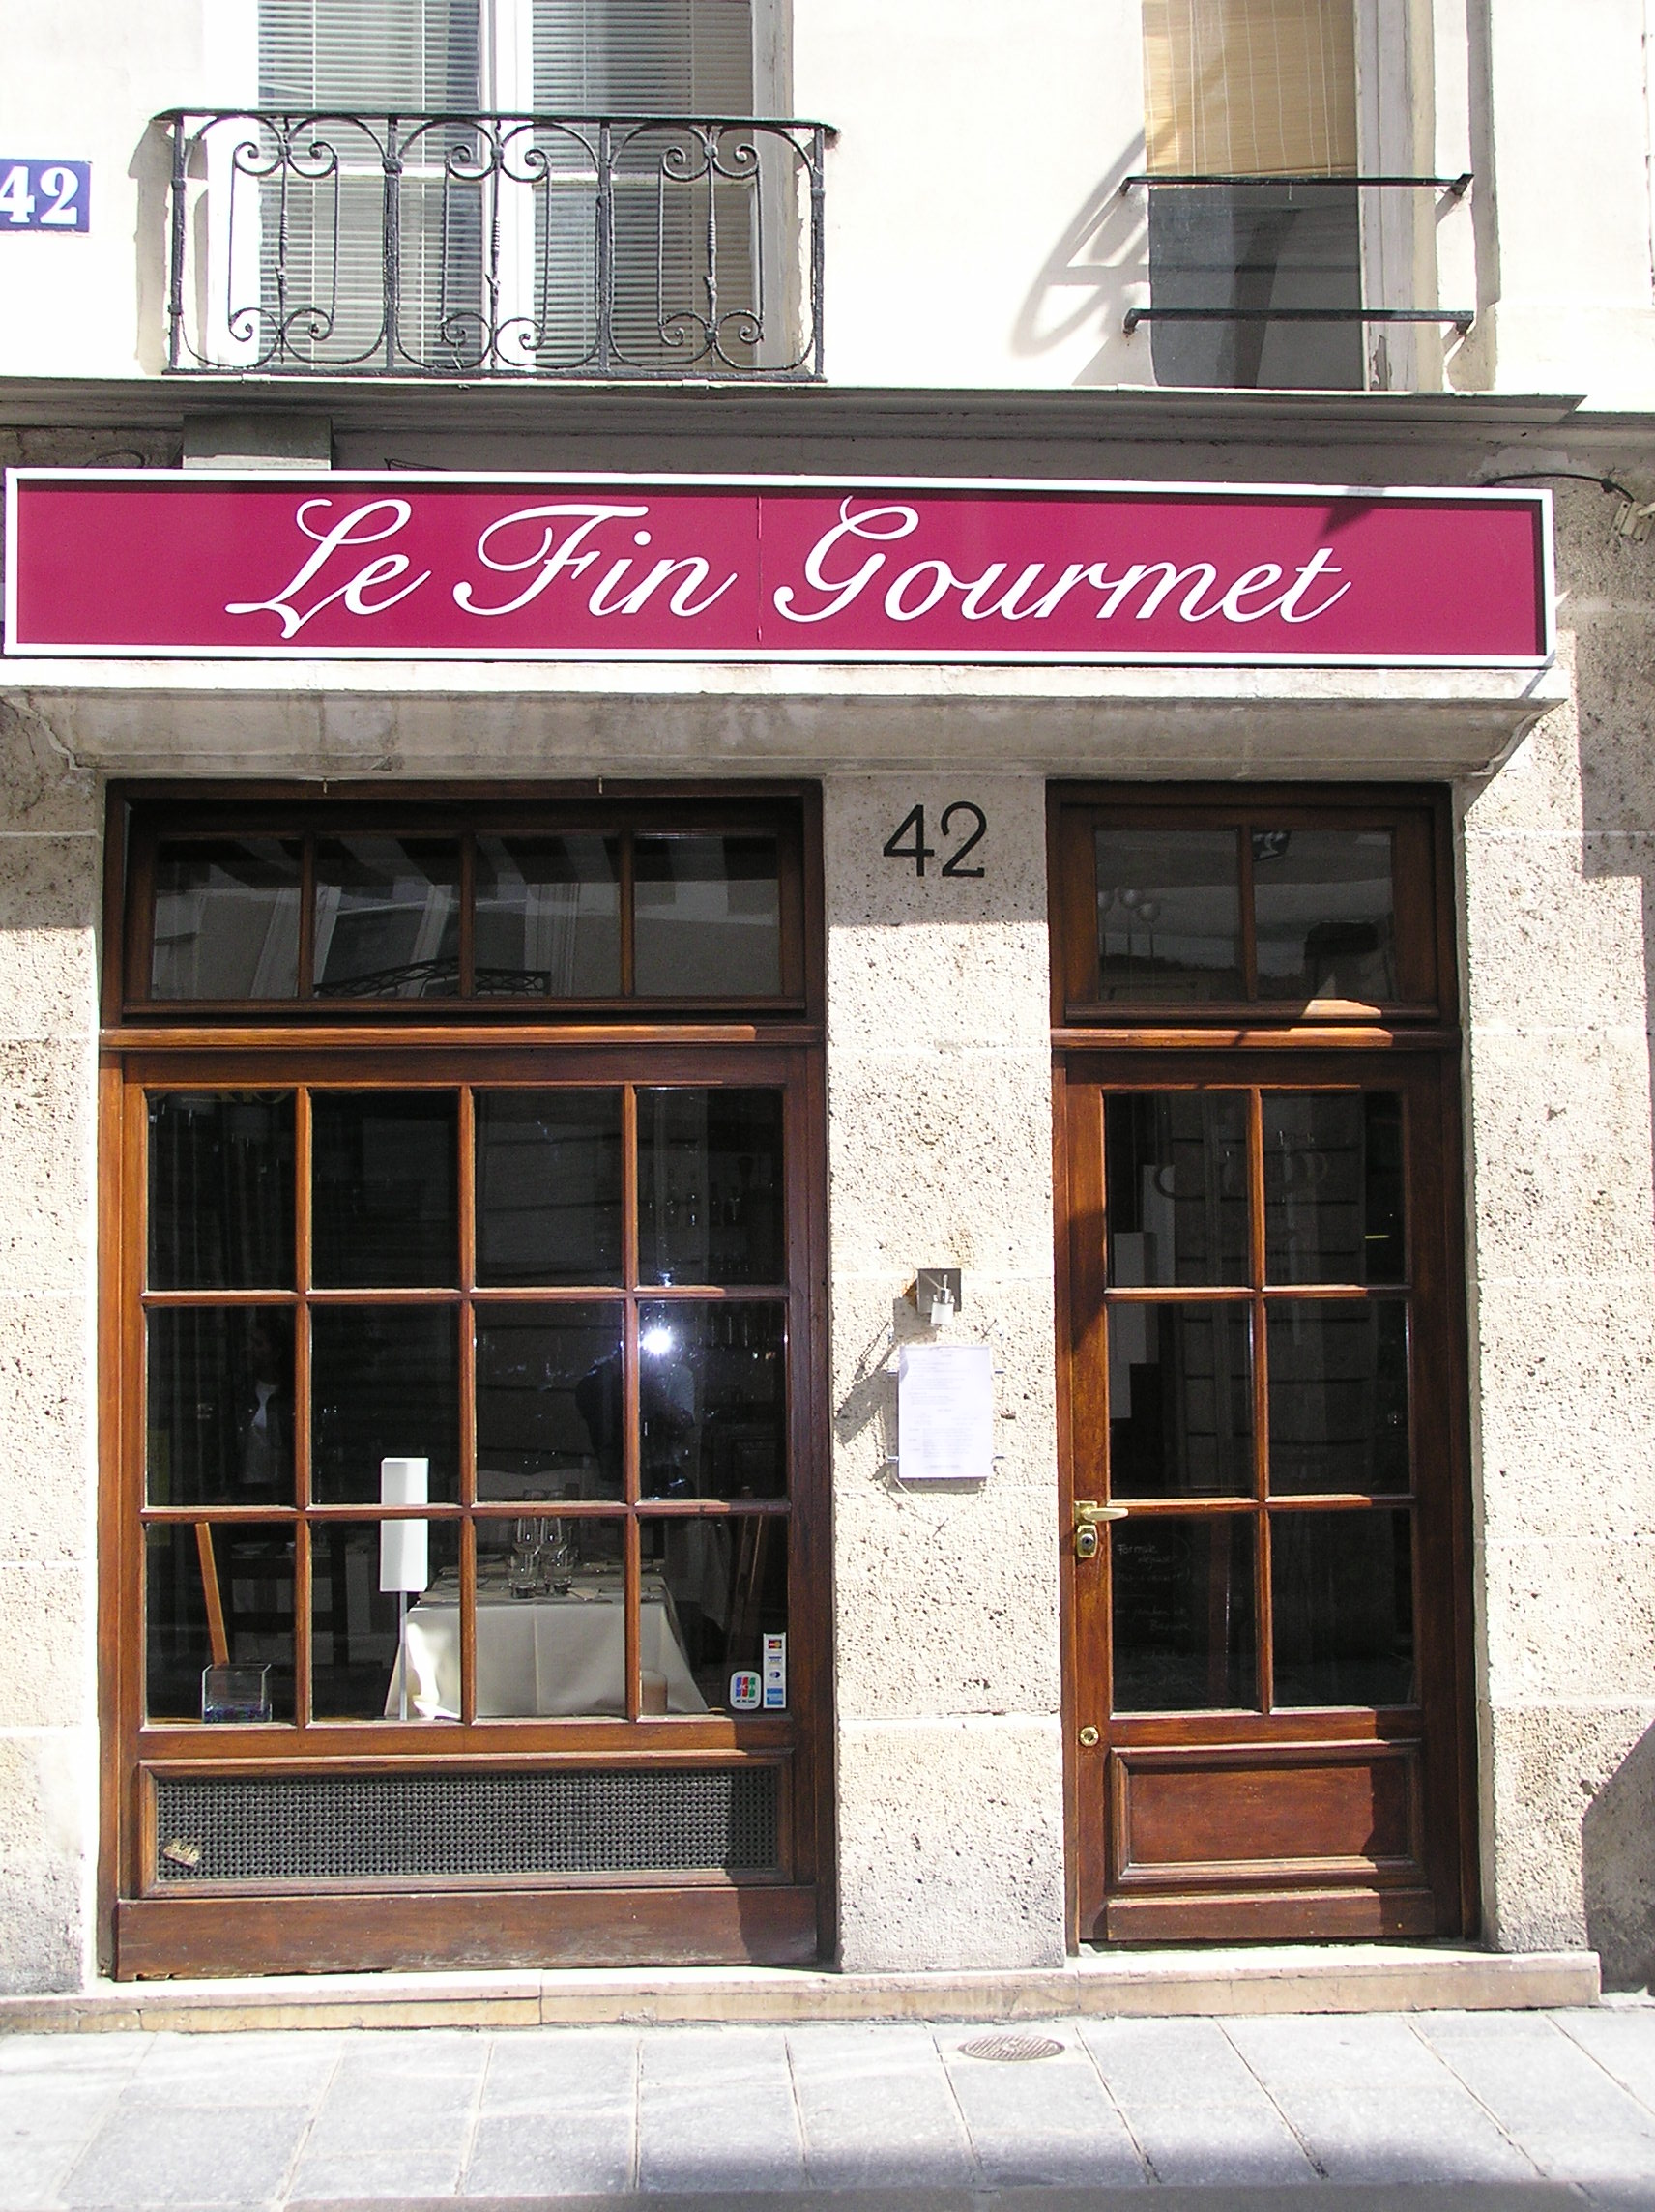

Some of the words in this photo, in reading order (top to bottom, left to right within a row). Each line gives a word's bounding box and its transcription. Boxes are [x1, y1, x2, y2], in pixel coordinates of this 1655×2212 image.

[0, 165, 79, 225] 42
[224, 498, 432, 639] Le
[452, 504, 738, 617] Fin
[773, 495, 1352, 624] Gourmet
[883, 800, 988, 879] 42
